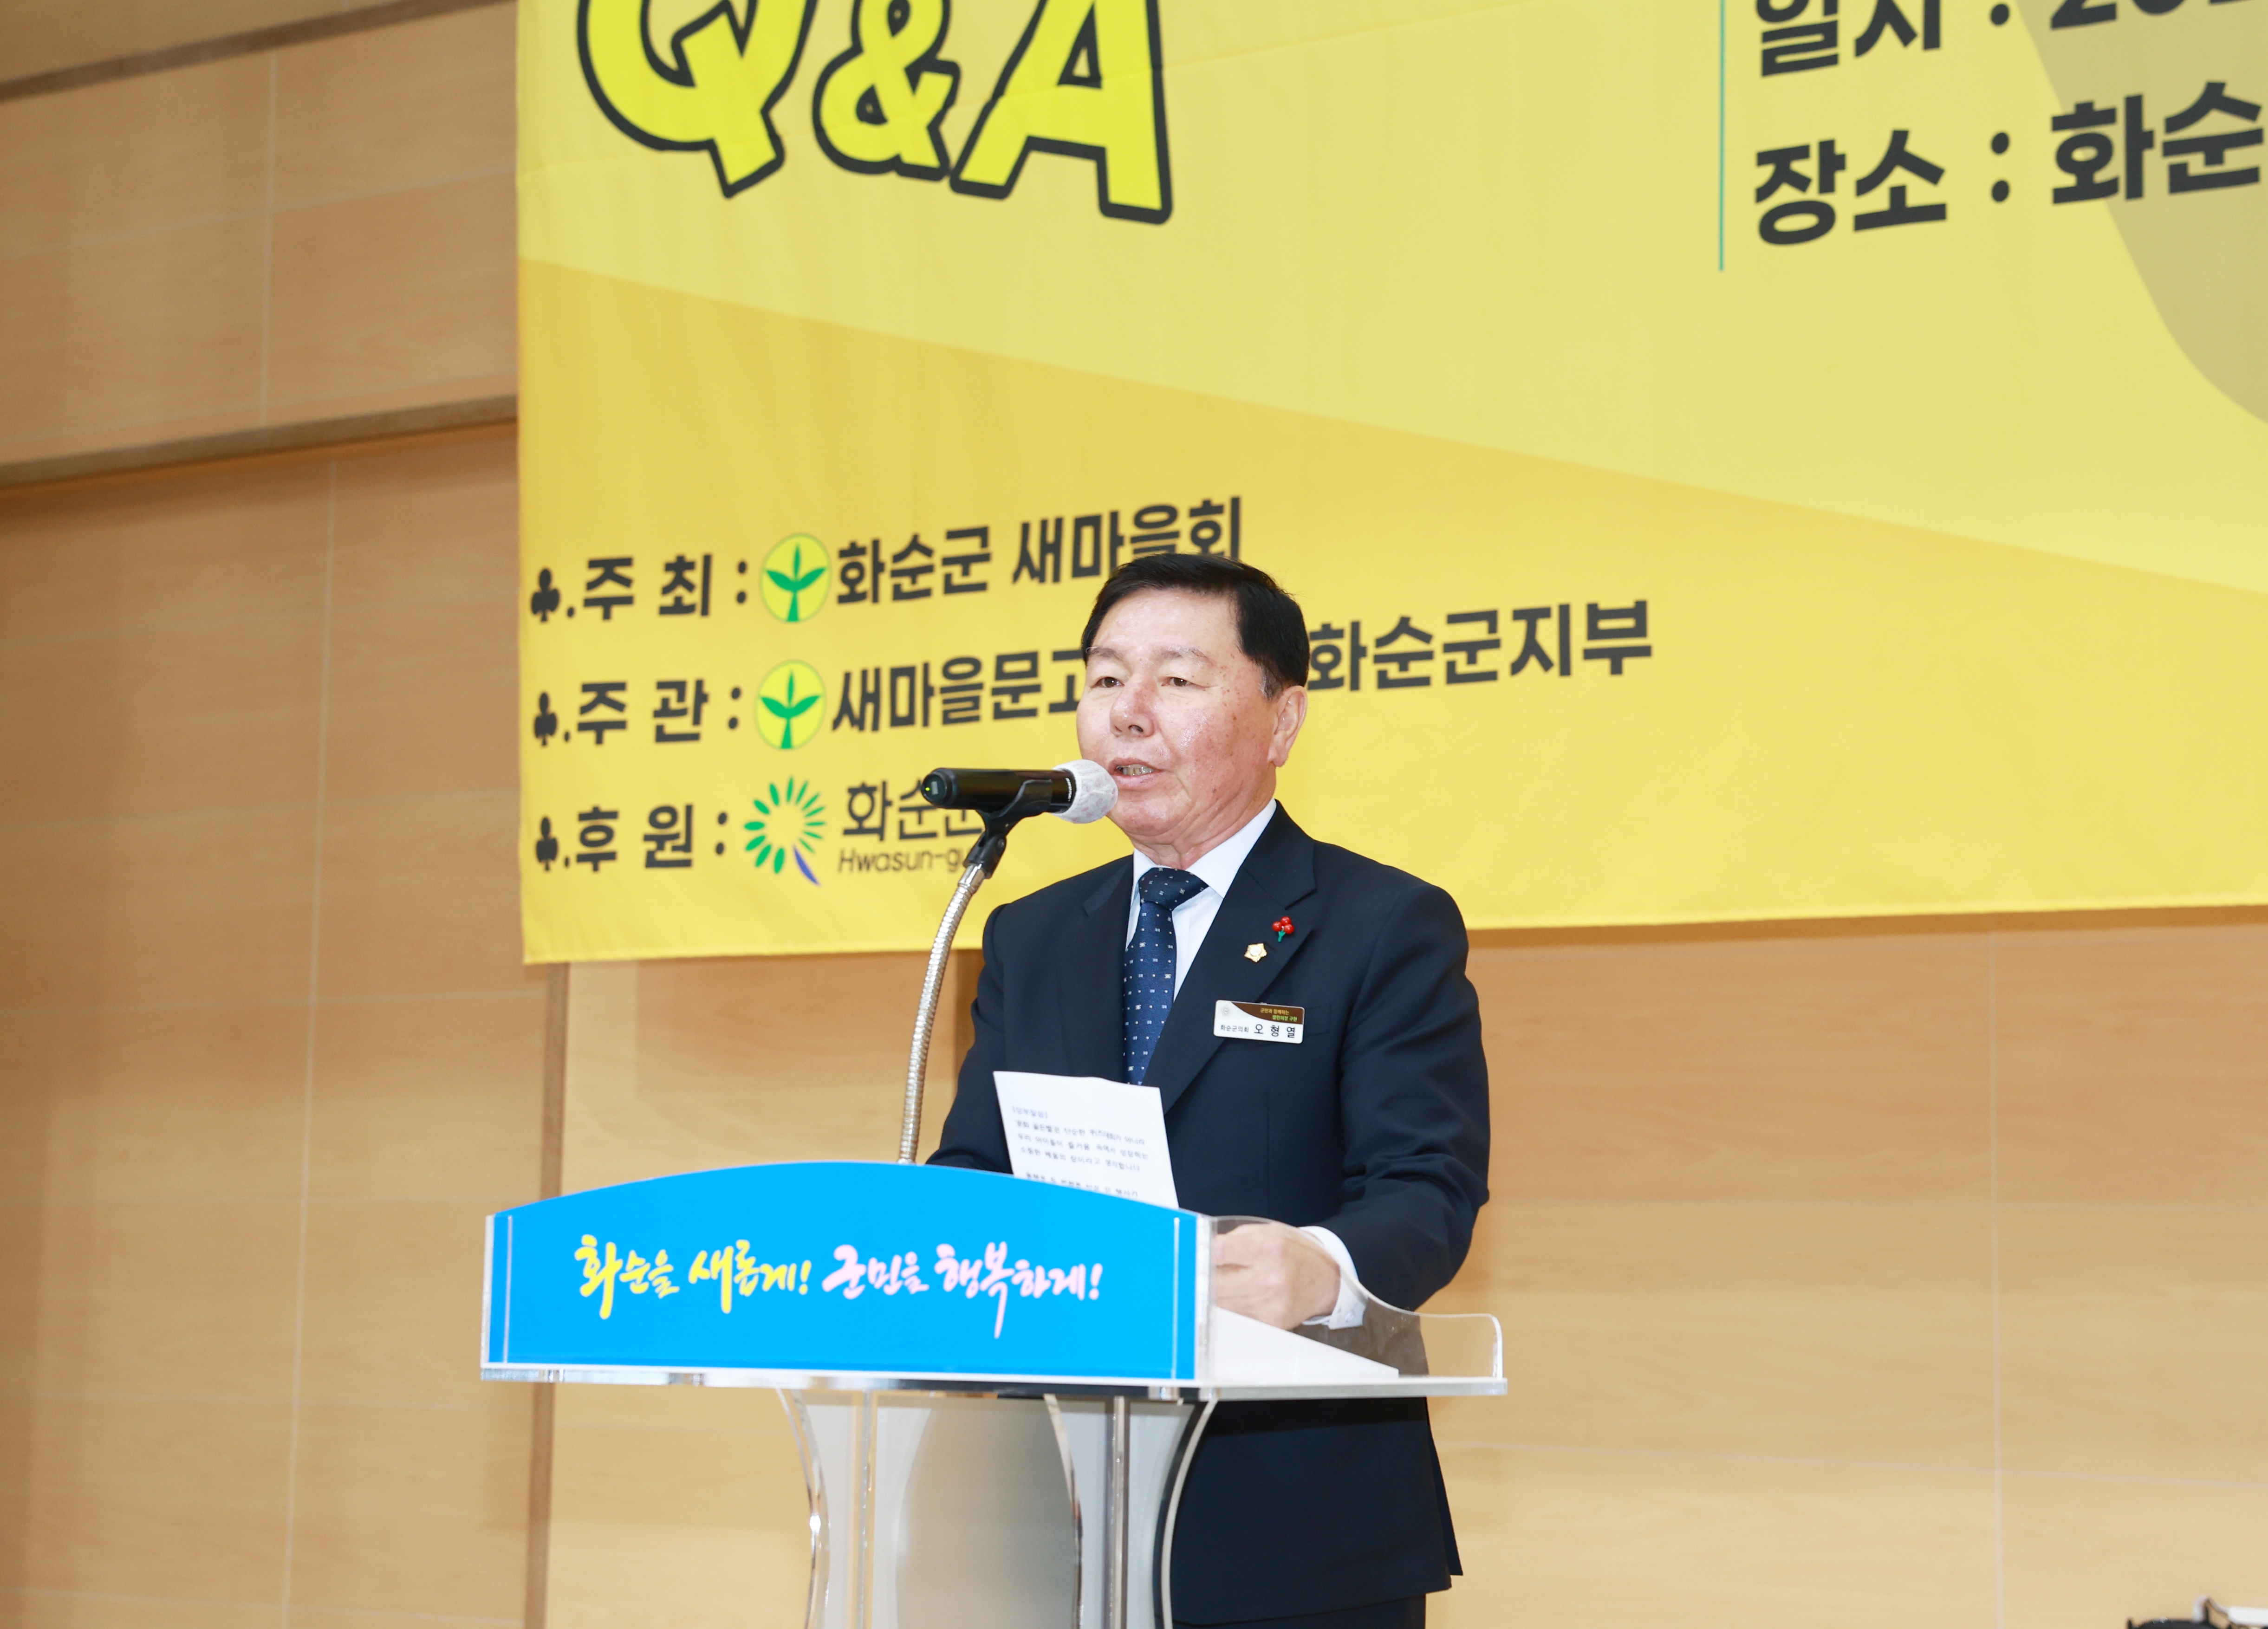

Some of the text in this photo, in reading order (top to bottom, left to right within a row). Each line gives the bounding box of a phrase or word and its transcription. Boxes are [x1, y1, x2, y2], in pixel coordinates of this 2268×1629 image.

[576, 0, 1172, 224] Q&A
[1755, 129, 1948, 245] 장소
[2051, 82, 2264, 204] 화순
[837, 525, 992, 604] 화순군
[1011, 496, 1241, 584] 새마을회
[1308, 599, 1653, 692] 화순군지부
[1220, 1025, 1249, 1033] 화순군의회
[934, 1240, 1103, 1340] 행복하게!
